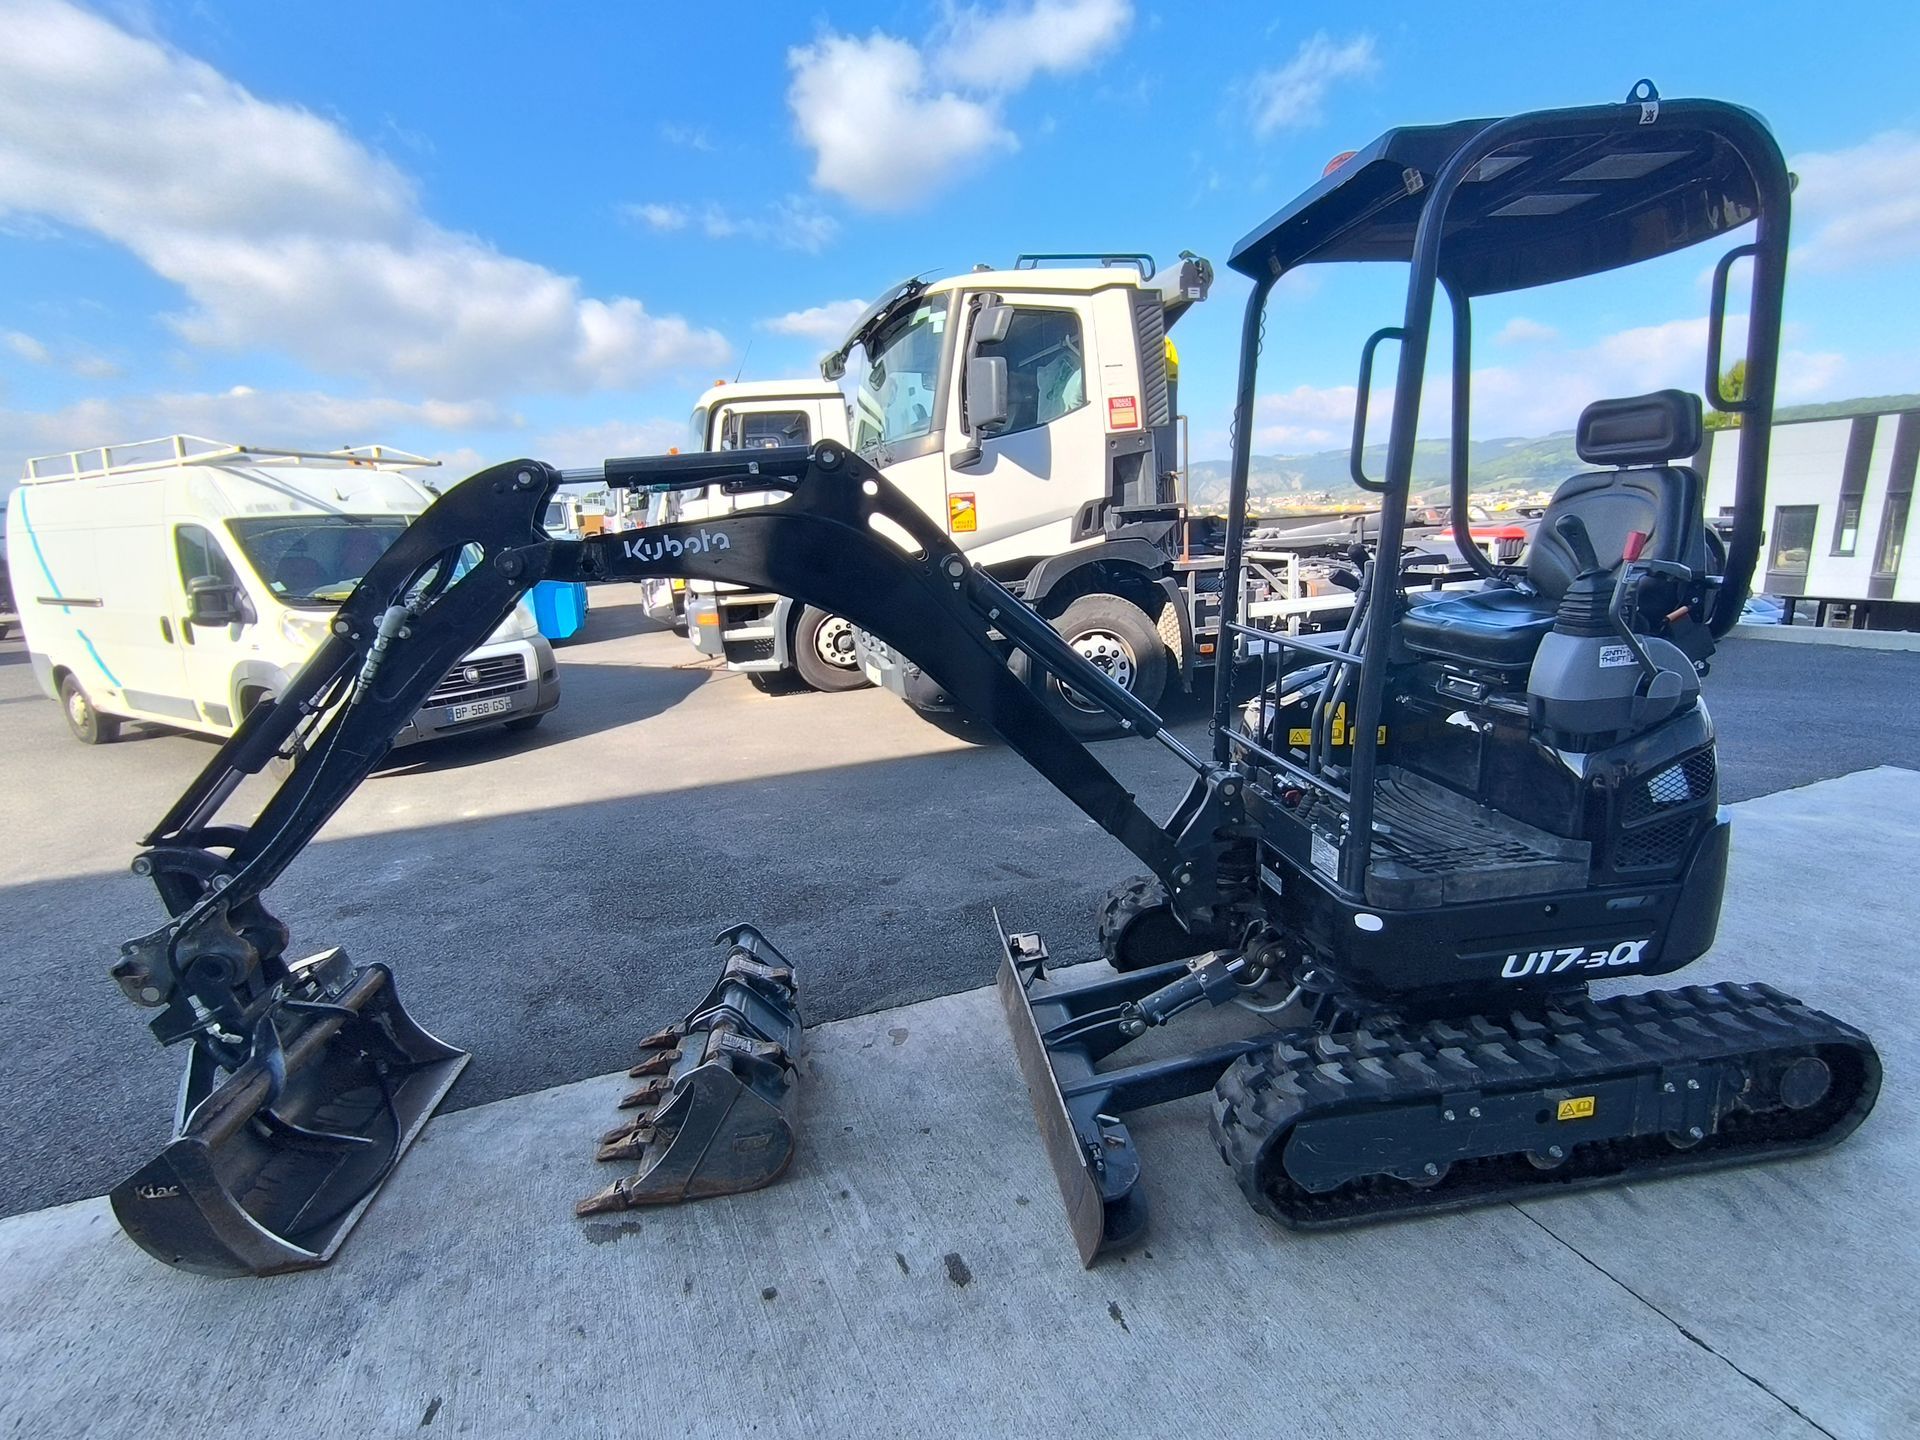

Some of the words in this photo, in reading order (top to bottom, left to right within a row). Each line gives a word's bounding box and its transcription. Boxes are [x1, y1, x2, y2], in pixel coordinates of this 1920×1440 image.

[623, 528, 731, 562] Kubota
[1601, 655, 1626, 663] THEFT
[455, 700, 505, 719] BP-568-GS
